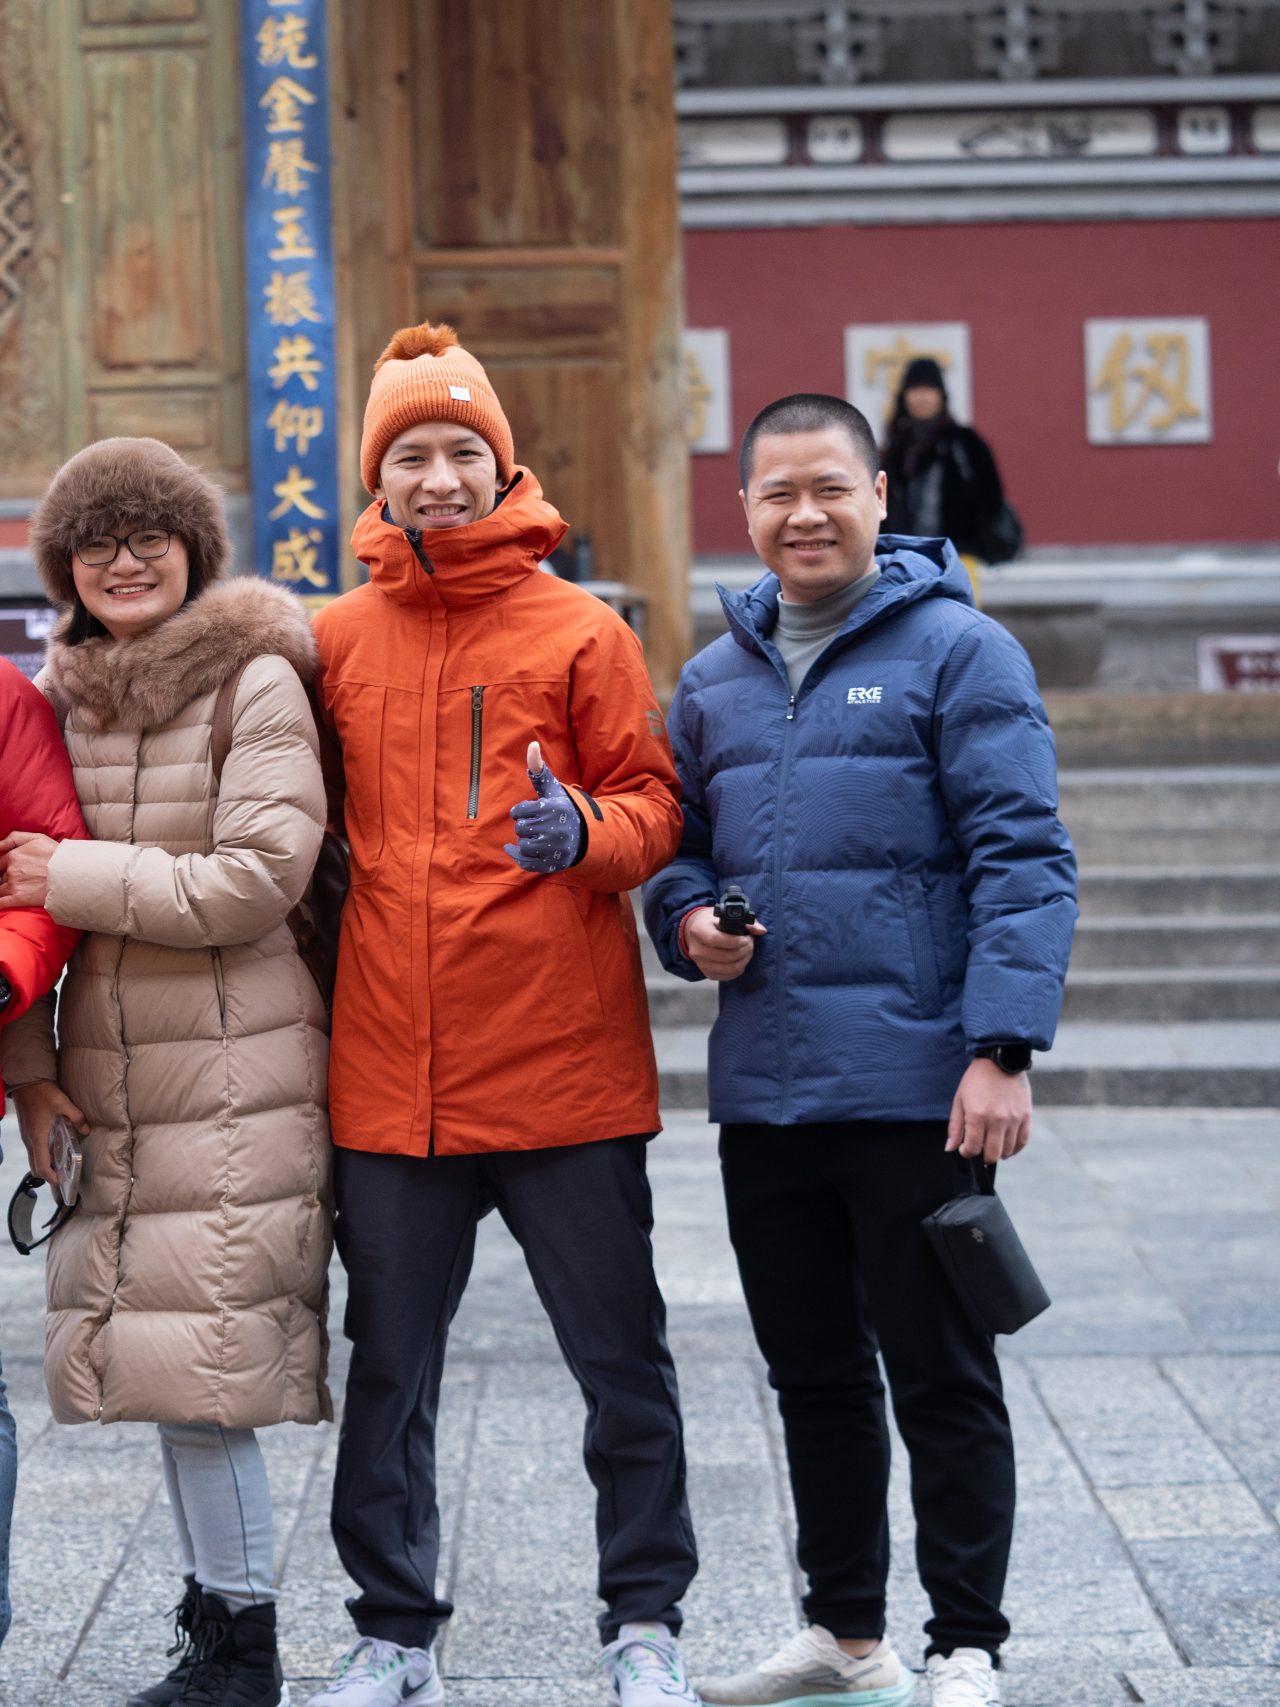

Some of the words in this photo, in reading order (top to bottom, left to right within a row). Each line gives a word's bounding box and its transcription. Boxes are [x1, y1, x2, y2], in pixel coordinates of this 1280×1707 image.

[257, 0, 329, 588] 統金聲玉振共仰大成
[847, 686, 883, 700] ERKE
